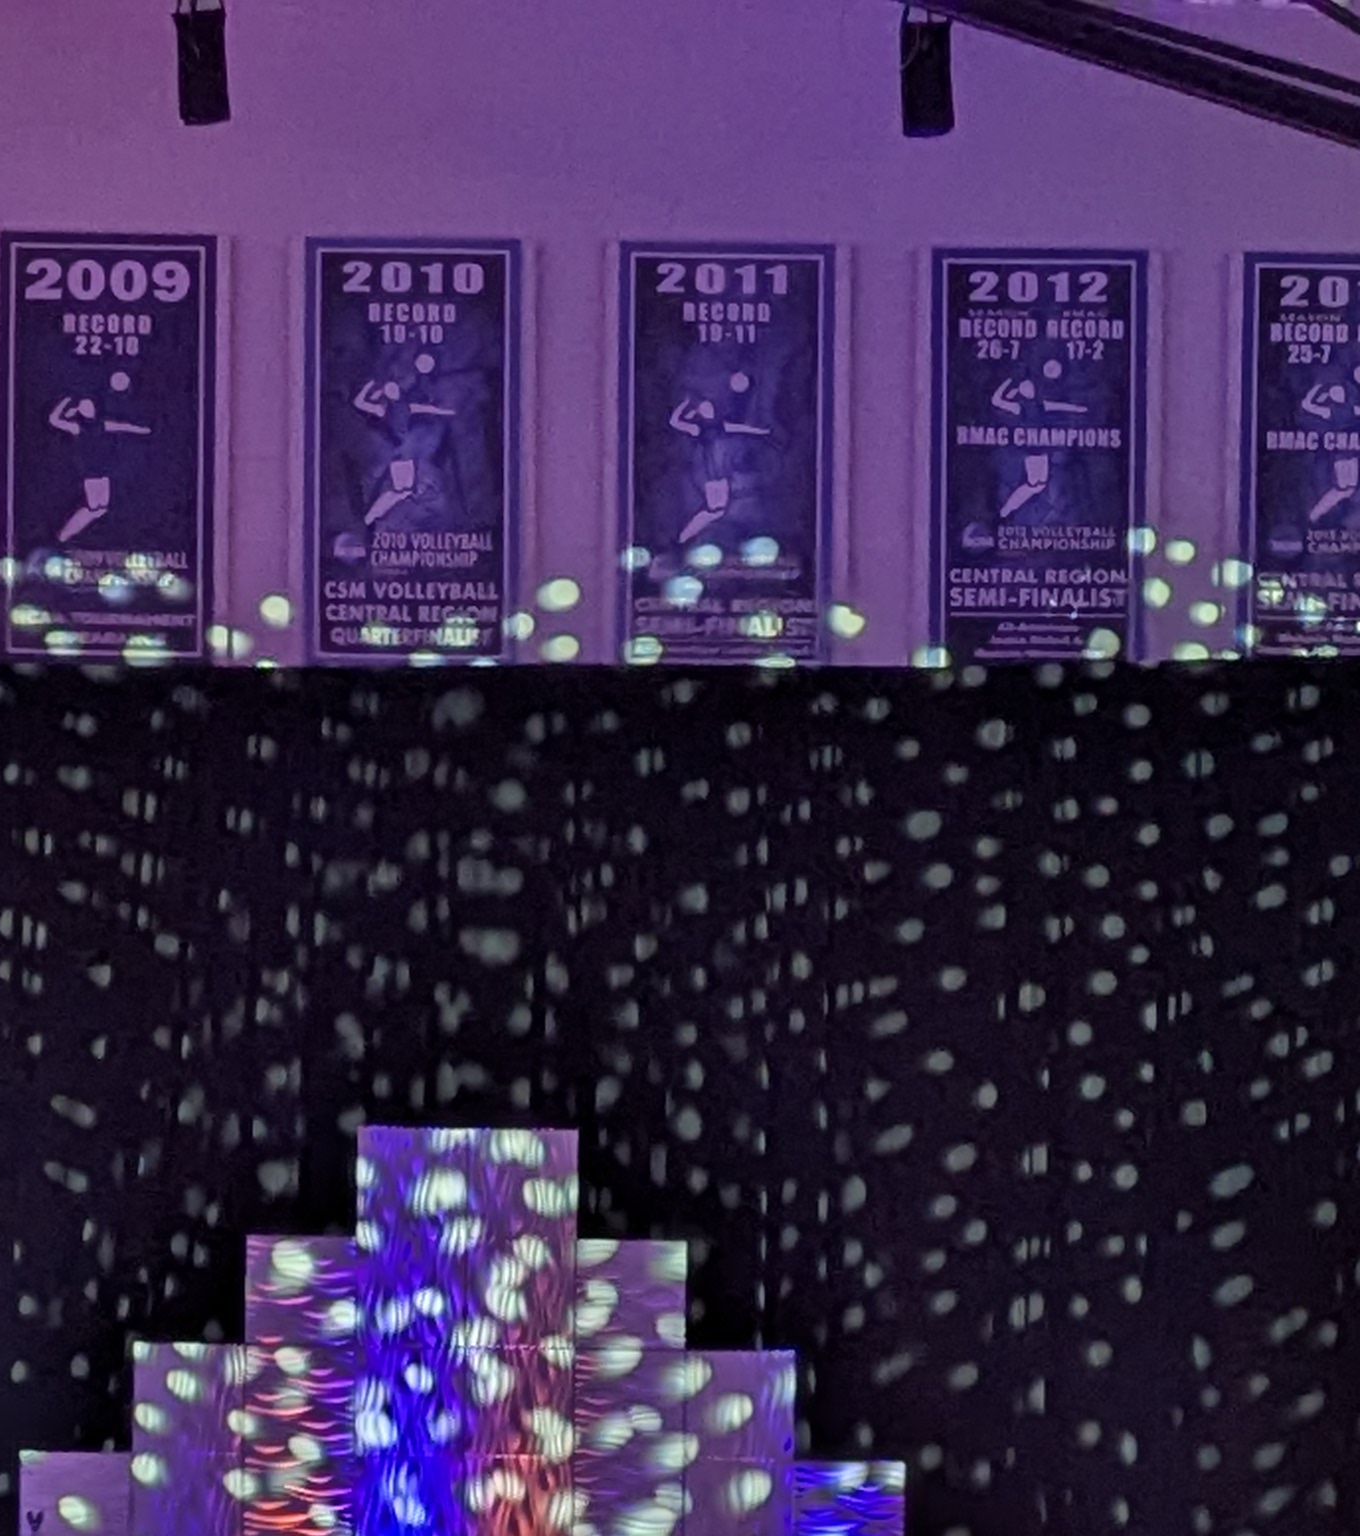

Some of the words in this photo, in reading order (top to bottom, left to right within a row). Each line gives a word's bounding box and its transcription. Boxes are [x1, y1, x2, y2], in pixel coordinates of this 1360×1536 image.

[25, 258, 190, 302] 2009
[342, 261, 484, 294] 2010
[656, 262, 788, 295] 2011
[968, 271, 1108, 303] 2012
[368, 302, 456, 323] RECORD
[683, 302, 770, 322] RECORD
[63, 313, 152, 335] RECORD
[959, 318, 1037, 339] RECORD
[1046, 319, 1124, 340] RECORD
[1270, 323, 1349, 343] RECORD
[1066, 339, 1104, 360] 17-2
[1287, 344, 1331, 364] 25-7
[956, 425, 1009, 446] RMAC
[1013, 427, 1122, 448] CHAMPIONS
[1266, 431, 1319, 450] RMAC
[373, 532, 406, 549] 2010
[411, 533, 494, 551] VOLLEYBALL
[1031, 526, 1117, 539] VOLLEYBALL
[997, 538, 1117, 550] CHAMPIONSHIP
[371, 551, 478, 568] CHAMPIONSHIP
[949, 568, 1038, 584] CENTRAL
[1044, 569, 1128, 585] REGION
[1257, 572, 1347, 589] CENTRAL
[324, 581, 366, 600] CSM
[372, 581, 499, 602] VOLLEYBALL
[949, 587, 1127, 608] SEMI-FINALIST
[325, 604, 412, 622] CENTRAL
[417, 605, 498, 624] REGION
[330, 626, 494, 647] QUARTERFINALIST
